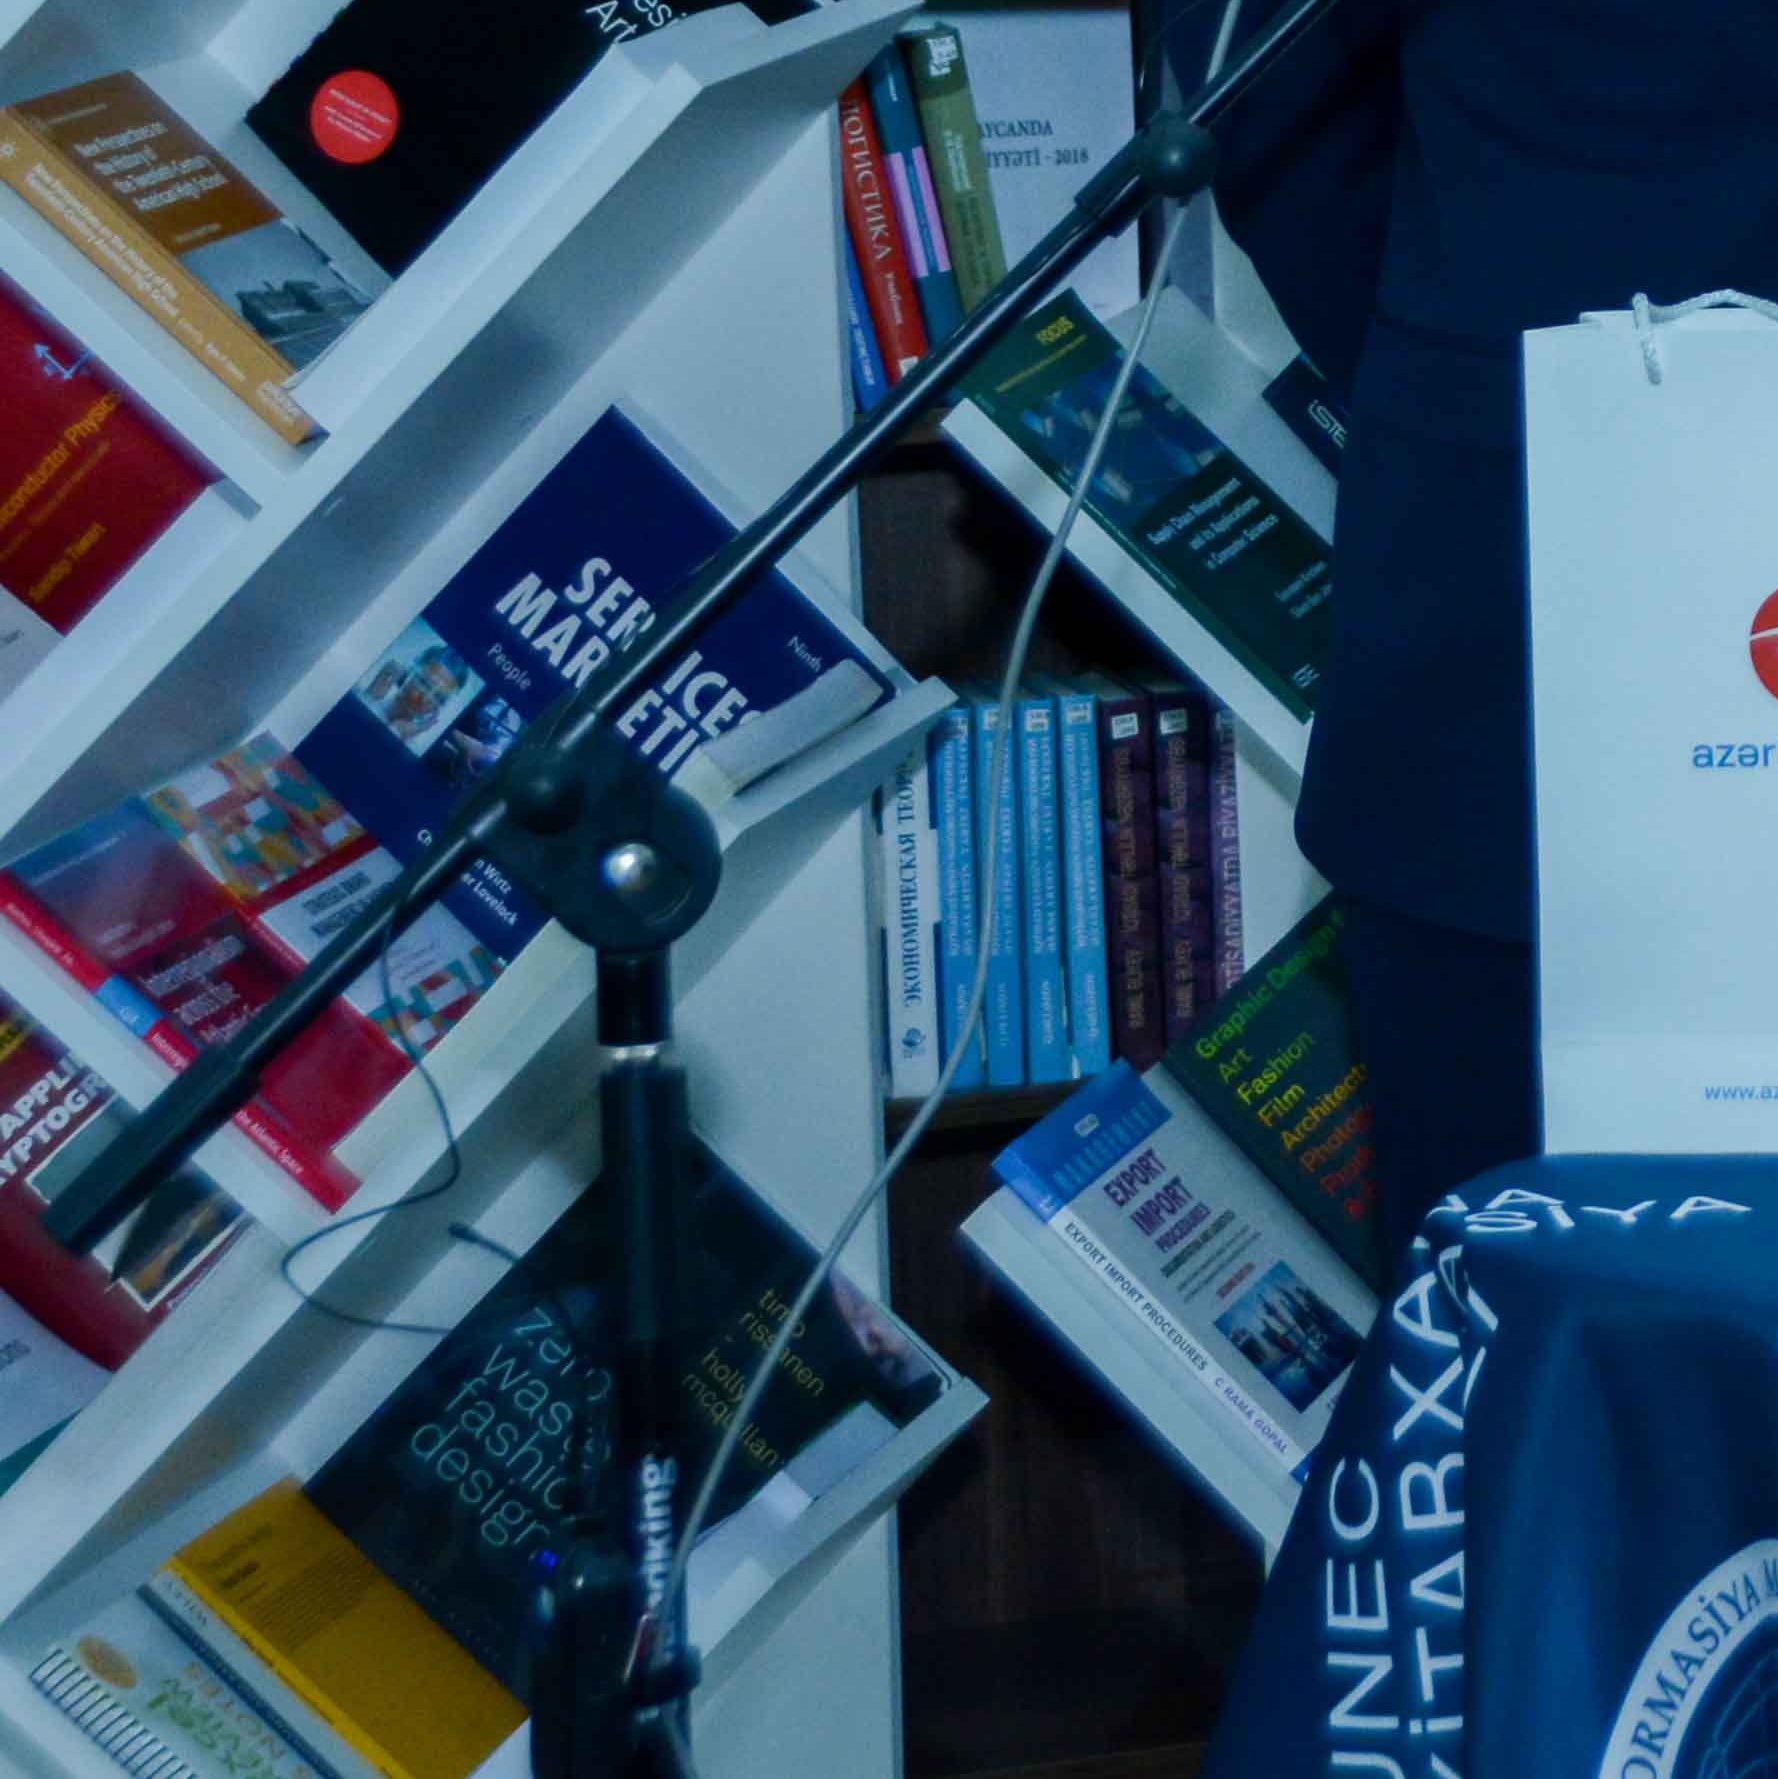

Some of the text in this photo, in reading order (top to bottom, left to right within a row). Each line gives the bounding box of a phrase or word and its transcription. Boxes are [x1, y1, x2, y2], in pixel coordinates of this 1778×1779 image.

[839, 98, 894, 261] ЛОГИСТИКА
[487, 643, 532, 692] People
[495, 572, 701, 773] MARETI
[565, 556, 761, 738] SERICE
[787, 636, 824, 676] Ninth
[896, 833, 922, 1007] ЭКОНОМИЧЕСКАЯ
[1219, 845, 1243, 988] QTİSADİYYATDA
[1195, 990, 1273, 1063] Graphic
[1217, 1046, 1254, 1086] Art
[1237, 1030, 1317, 1107] Fashion
[1256, 1079, 1308, 1128] Film
[1281, 1064, 1368, 1152] Architect
[1102, 1149, 1167, 1210] EXPORT
[1133, 1175, 1194, 1234] IMPORT
[1063, 1220, 1105, 1266] EXPORT
[1102, 1259, 1144, 1303] IMPORT
[1140, 1295, 1209, 1372] PROCEDURES
[446, 1376, 569, 1511] fashio
